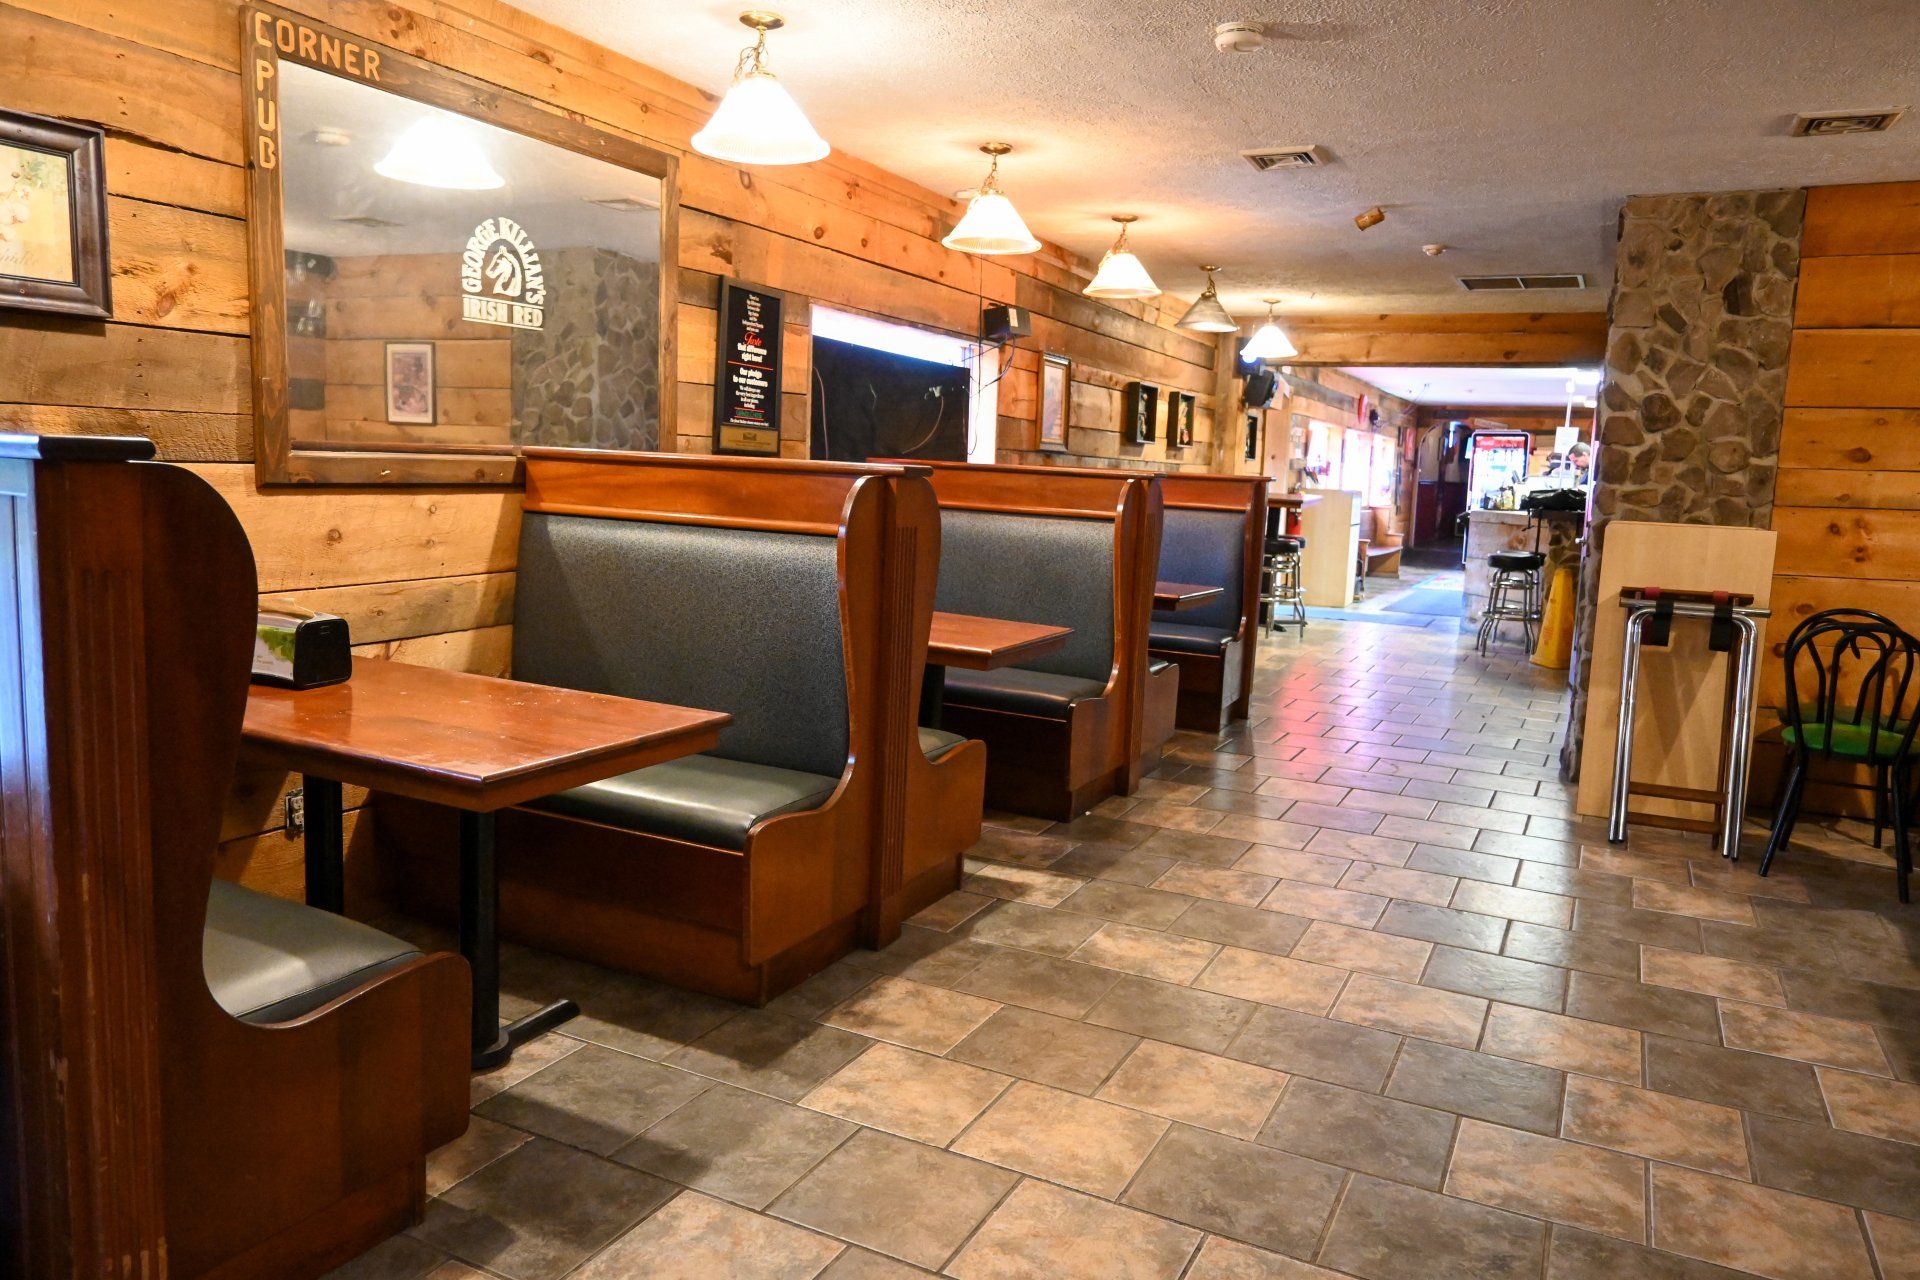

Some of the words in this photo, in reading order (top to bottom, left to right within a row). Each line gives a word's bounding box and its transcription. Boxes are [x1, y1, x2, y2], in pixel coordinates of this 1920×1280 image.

[255, 12, 381, 82] CORNER
[256, 59, 276, 169] PUB
[462, 218, 500, 293] GEORGE
[463, 298, 508, 323] IRISH
[512, 305, 543, 327] RED
[745, 332, 762, 347] Taste
